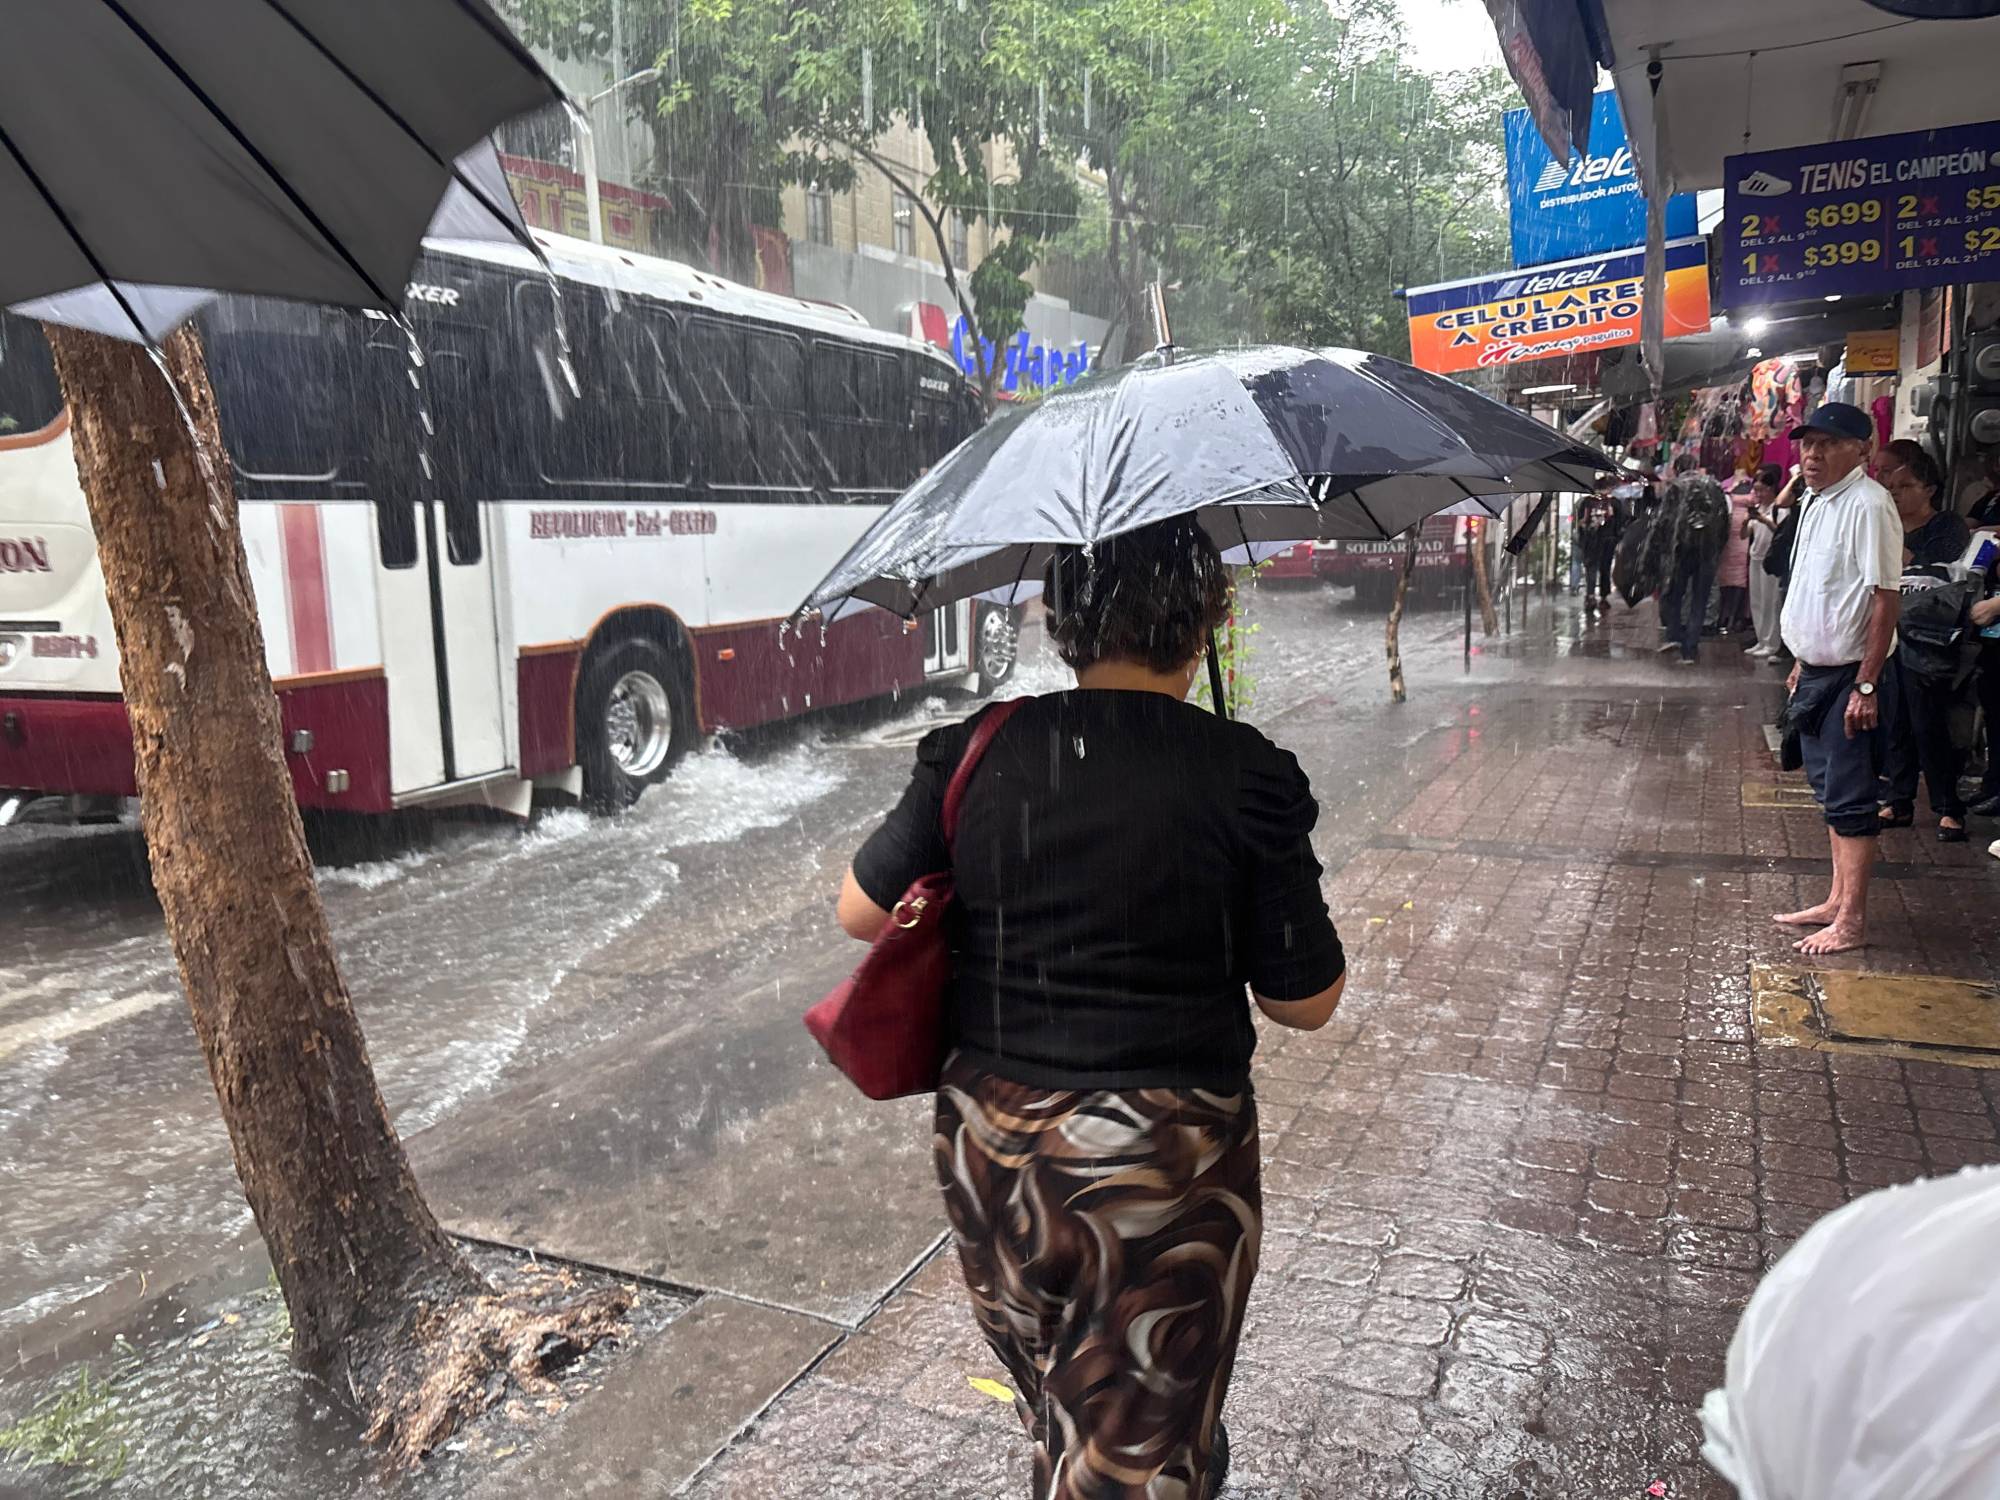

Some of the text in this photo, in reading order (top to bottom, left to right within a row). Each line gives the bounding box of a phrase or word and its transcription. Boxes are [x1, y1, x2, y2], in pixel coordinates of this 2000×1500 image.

[1800, 147, 1986, 194] TENIS EL CAMPEÓN
[1540, 187, 1606, 209] DISTRIBUIDOR
[1897, 195, 1918, 219] 2
[1741, 215, 1760, 238] 2
[1805, 200, 1881, 228] $699
[1897, 221, 1922, 230] DEL
[1927, 219, 1940, 227] 12
[1944, 217, 1961, 225] AL
[1740, 238, 1765, 247] DEL
[1768, 236, 1776, 244] 2
[1778, 234, 1794, 242] AL
[1899, 235, 1914, 258] 1
[1743, 253, 1757, 275] 1
[1804, 239, 1881, 267] $399
[1895, 260, 1921, 270] DEL
[1926, 258, 1940, 266] 12
[1942, 256, 1960, 265] AL
[1523, 263, 1606, 294] telcel
[1739, 276, 1764, 286] DEL
[1767, 275, 1775, 283] 2
[1777, 273, 1794, 281] AL
[404, 282, 459, 306] XER
[1451, 302, 1640, 347] A CRÉDITO
[1583, 328, 1632, 344] paguitos
[1345, 540, 1443, 555] SOLIDARDAD
